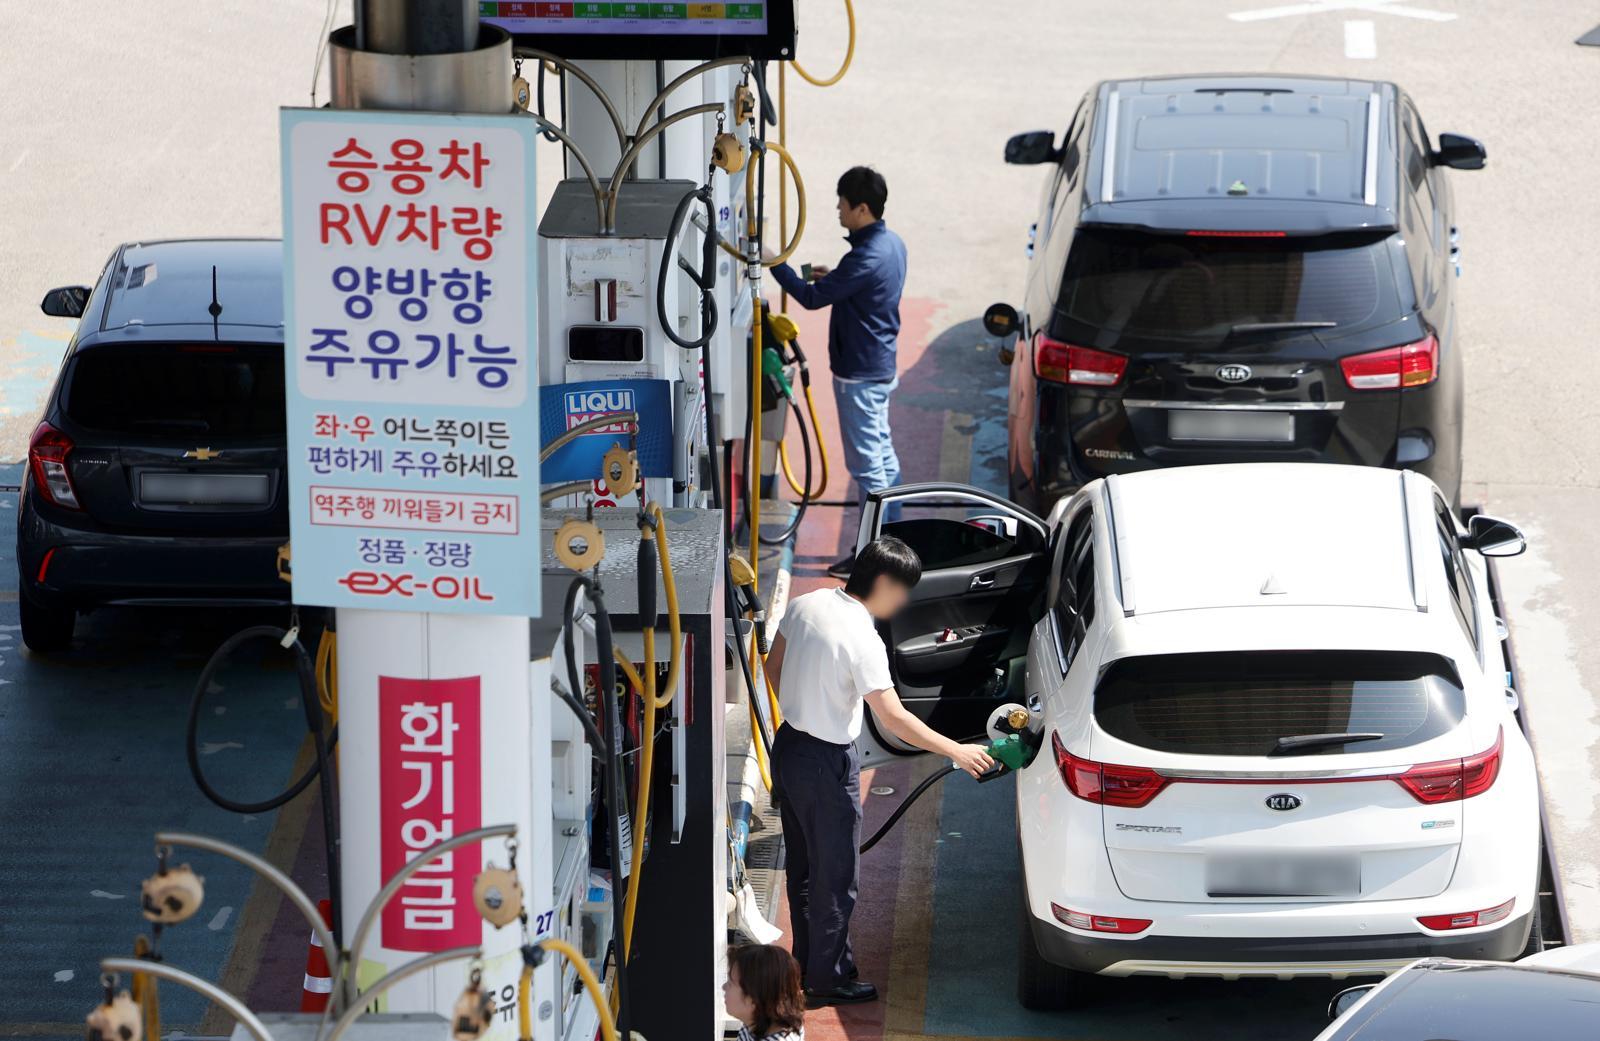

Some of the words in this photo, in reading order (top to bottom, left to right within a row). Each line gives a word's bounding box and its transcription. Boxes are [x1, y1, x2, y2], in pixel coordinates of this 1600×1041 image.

[328, 138, 490, 195] 승용차
[719, 207, 730, 221] 19
[320, 203, 502, 261] RV차량
[332, 266, 492, 324] 양방향
[305, 328, 517, 388] 주유가능
[569, 392, 631, 413] LIQUI
[314, 414, 375, 442] 좌·우
[383, 418, 510, 449] 어느쪽이든
[308, 446, 383, 474] 편하게
[391, 451, 518, 478] 주유하세요
[1085, 447, 1136, 461] CARNIVAL
[315, 494, 376, 520] 역주행
[383, 498, 464, 523] 끼워들기
[471, 502, 512, 525] 금지
[359, 538, 406, 564] 정품
[425, 542, 472, 568] 정량
[400, 702, 460, 930] 화기엄금
[536, 911, 554, 936] 27
